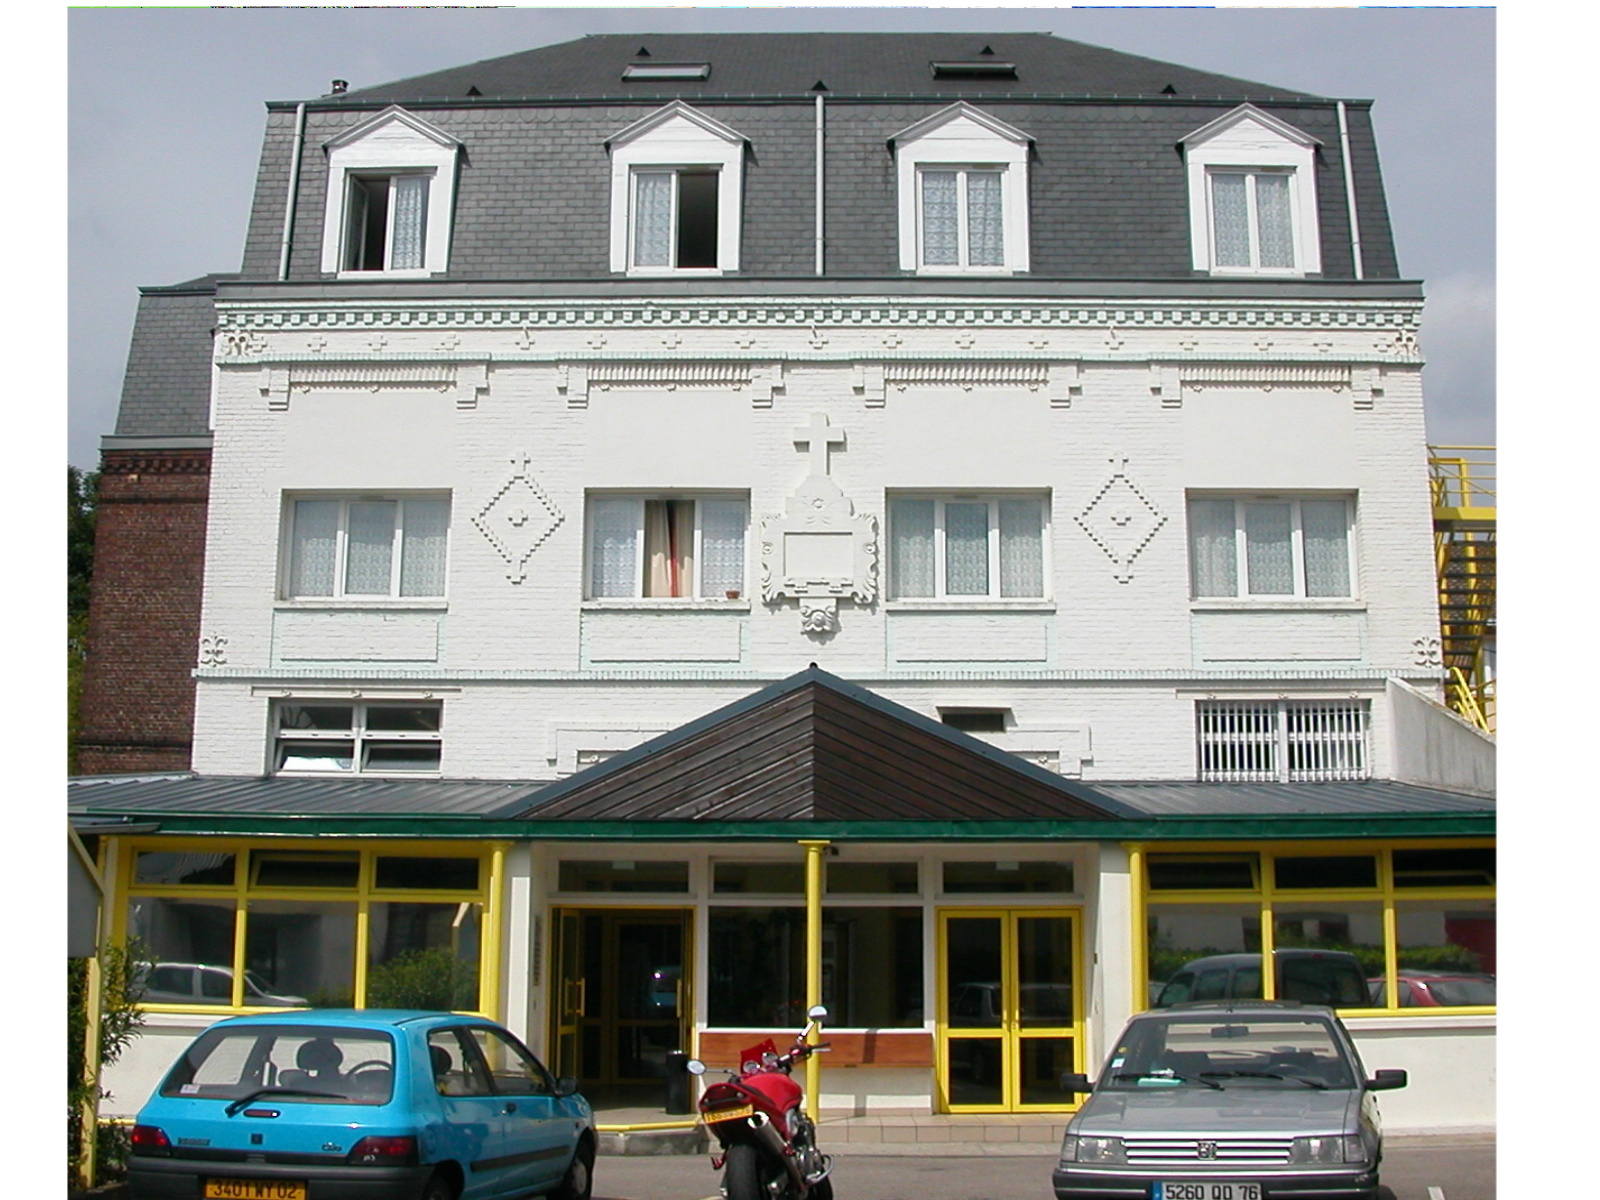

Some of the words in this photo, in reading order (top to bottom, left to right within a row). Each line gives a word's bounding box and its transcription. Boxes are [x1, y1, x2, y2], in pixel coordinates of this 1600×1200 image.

[214, 1180, 250, 1197] 3401
[254, 1181, 274, 1198] WY
[277, 1182, 297, 1199] 02
[1165, 1184, 1205, 1200] 5260
[1211, 1184, 1233, 1200] QD
[1238, 1184, 1259, 1200] 76
